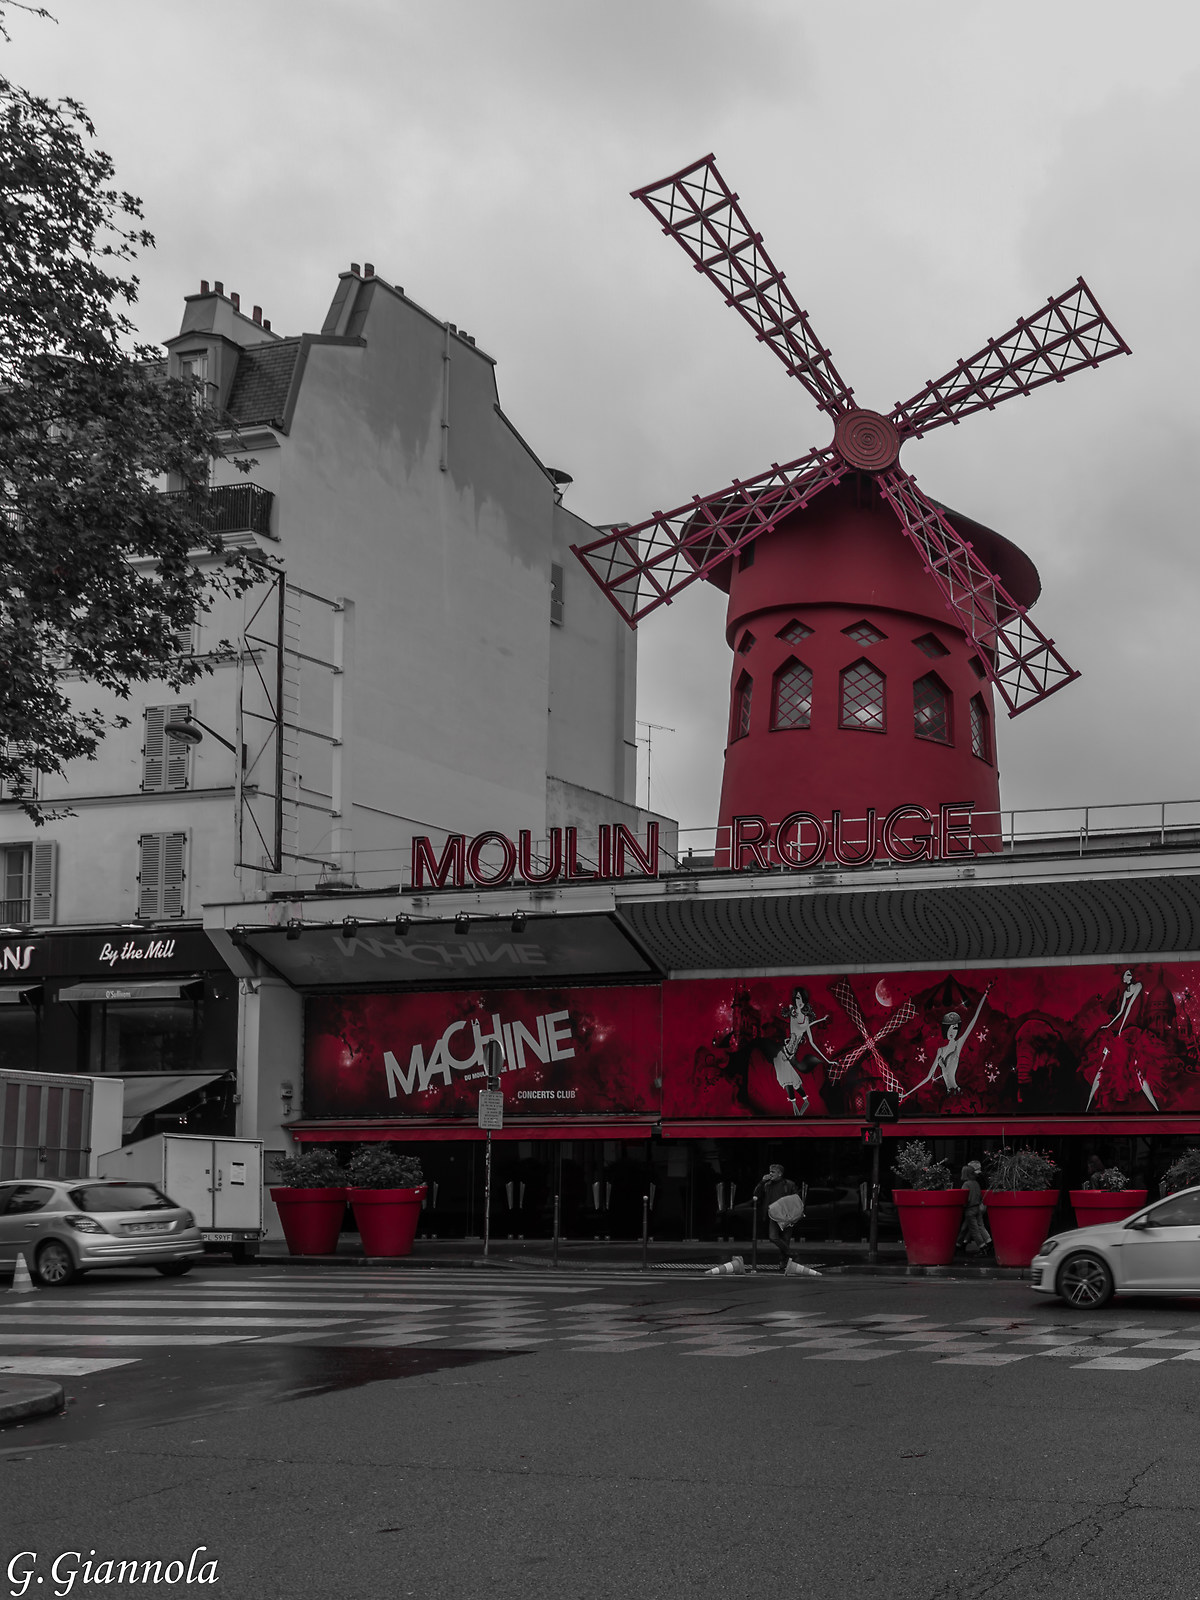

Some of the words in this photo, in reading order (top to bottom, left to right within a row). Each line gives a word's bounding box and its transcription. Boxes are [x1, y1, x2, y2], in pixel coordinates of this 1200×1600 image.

[411, 820, 660, 889] MOULIN
[731, 800, 977, 872] ROUGE
[0, 946, 36, 970] NS
[99, 942, 119, 967] By
[120, 941, 144, 960] the
[143, 939, 176, 959] Mill
[383, 1009, 576, 1099] MACHINE
[517, 1091, 555, 1099] CONCERTS
[556, 1091, 576, 1099] CLUB
